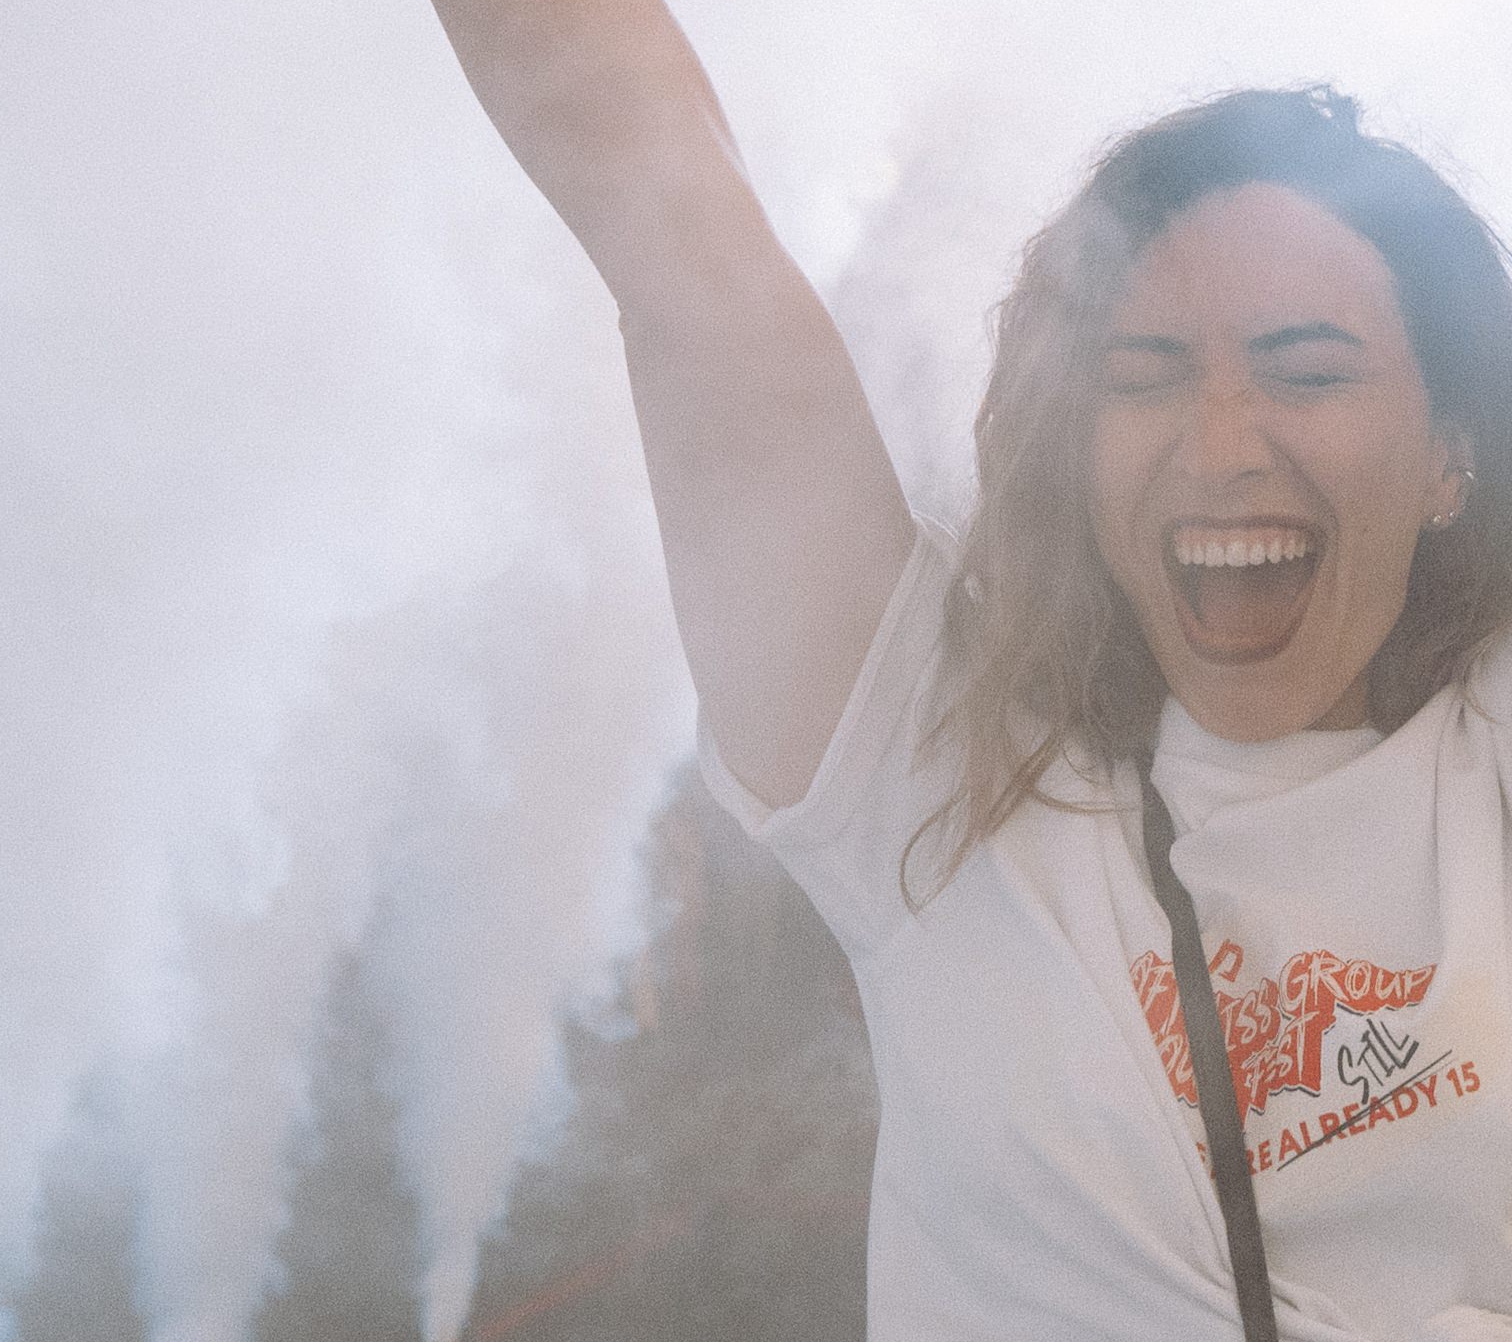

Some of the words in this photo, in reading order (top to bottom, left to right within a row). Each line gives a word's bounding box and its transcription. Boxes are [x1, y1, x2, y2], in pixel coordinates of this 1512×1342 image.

[1279, 952, 1435, 1012] GROUP
[1337, 1017, 1421, 1106] STILL
[1278, 1074, 1439, 1161] ALREADY
[1445, 1061, 1481, 1098] 15
